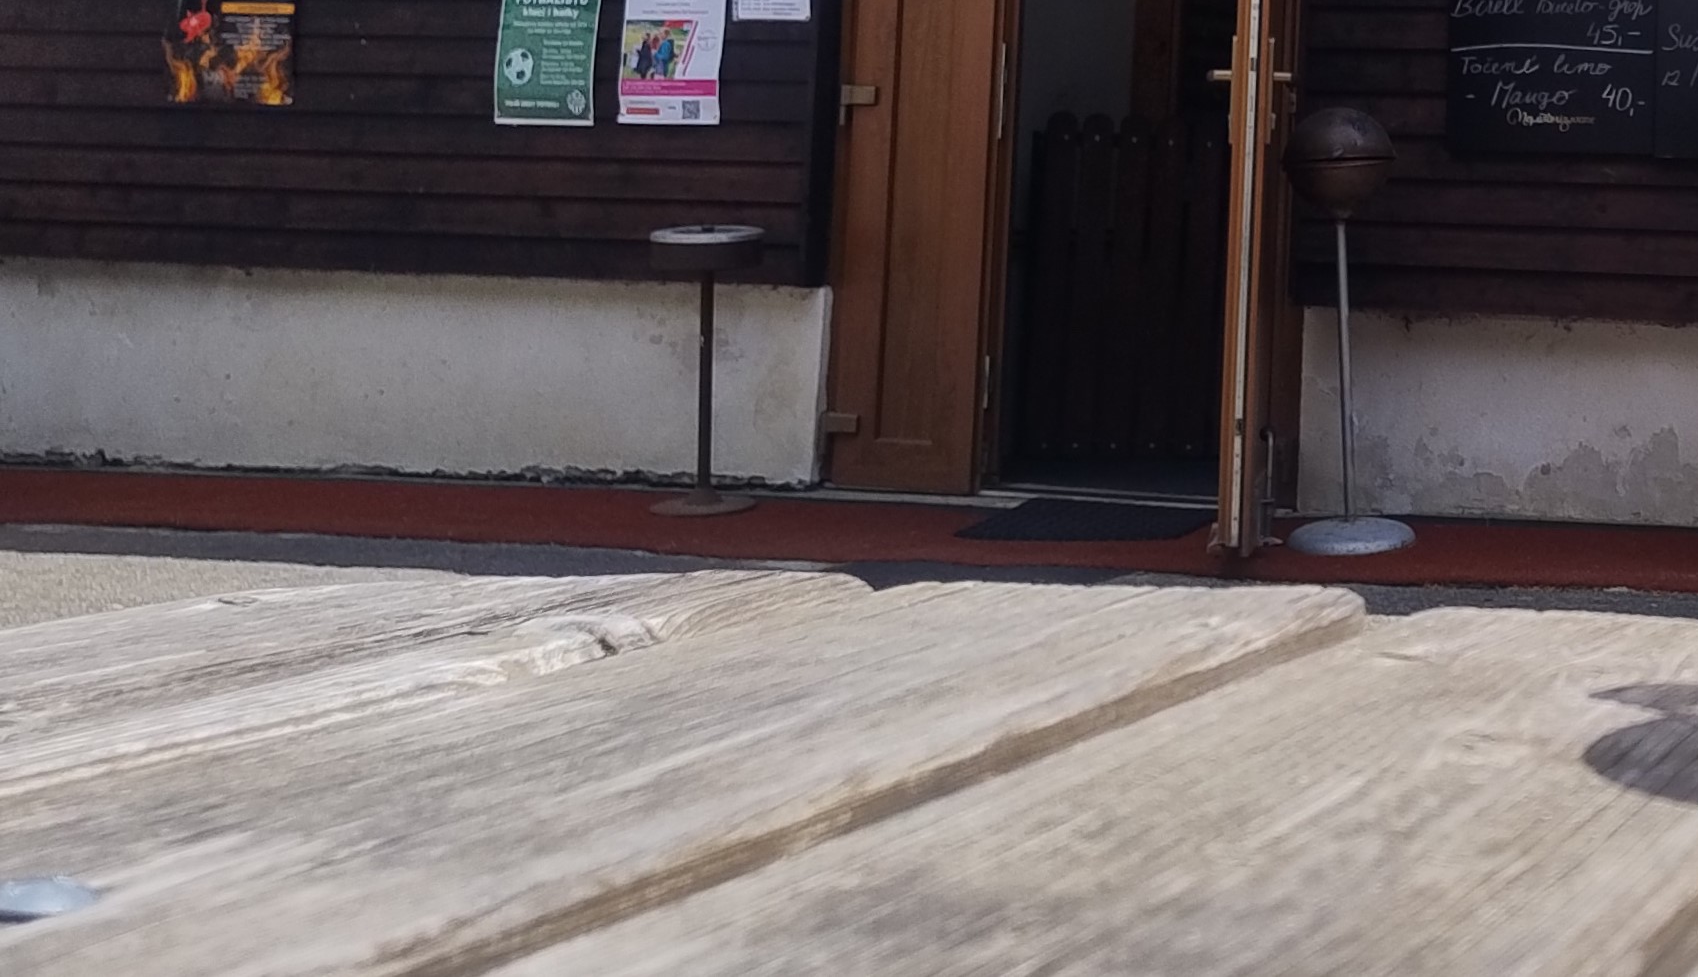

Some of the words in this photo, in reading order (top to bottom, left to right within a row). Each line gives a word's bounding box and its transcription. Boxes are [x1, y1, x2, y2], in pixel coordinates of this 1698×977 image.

[1586, 22, 1641, 46] 45,-
[1553, 54, 1613, 75] limo
[1490, 80, 1577, 110] Mango
[1601, 84, 1646, 117] 40,-
